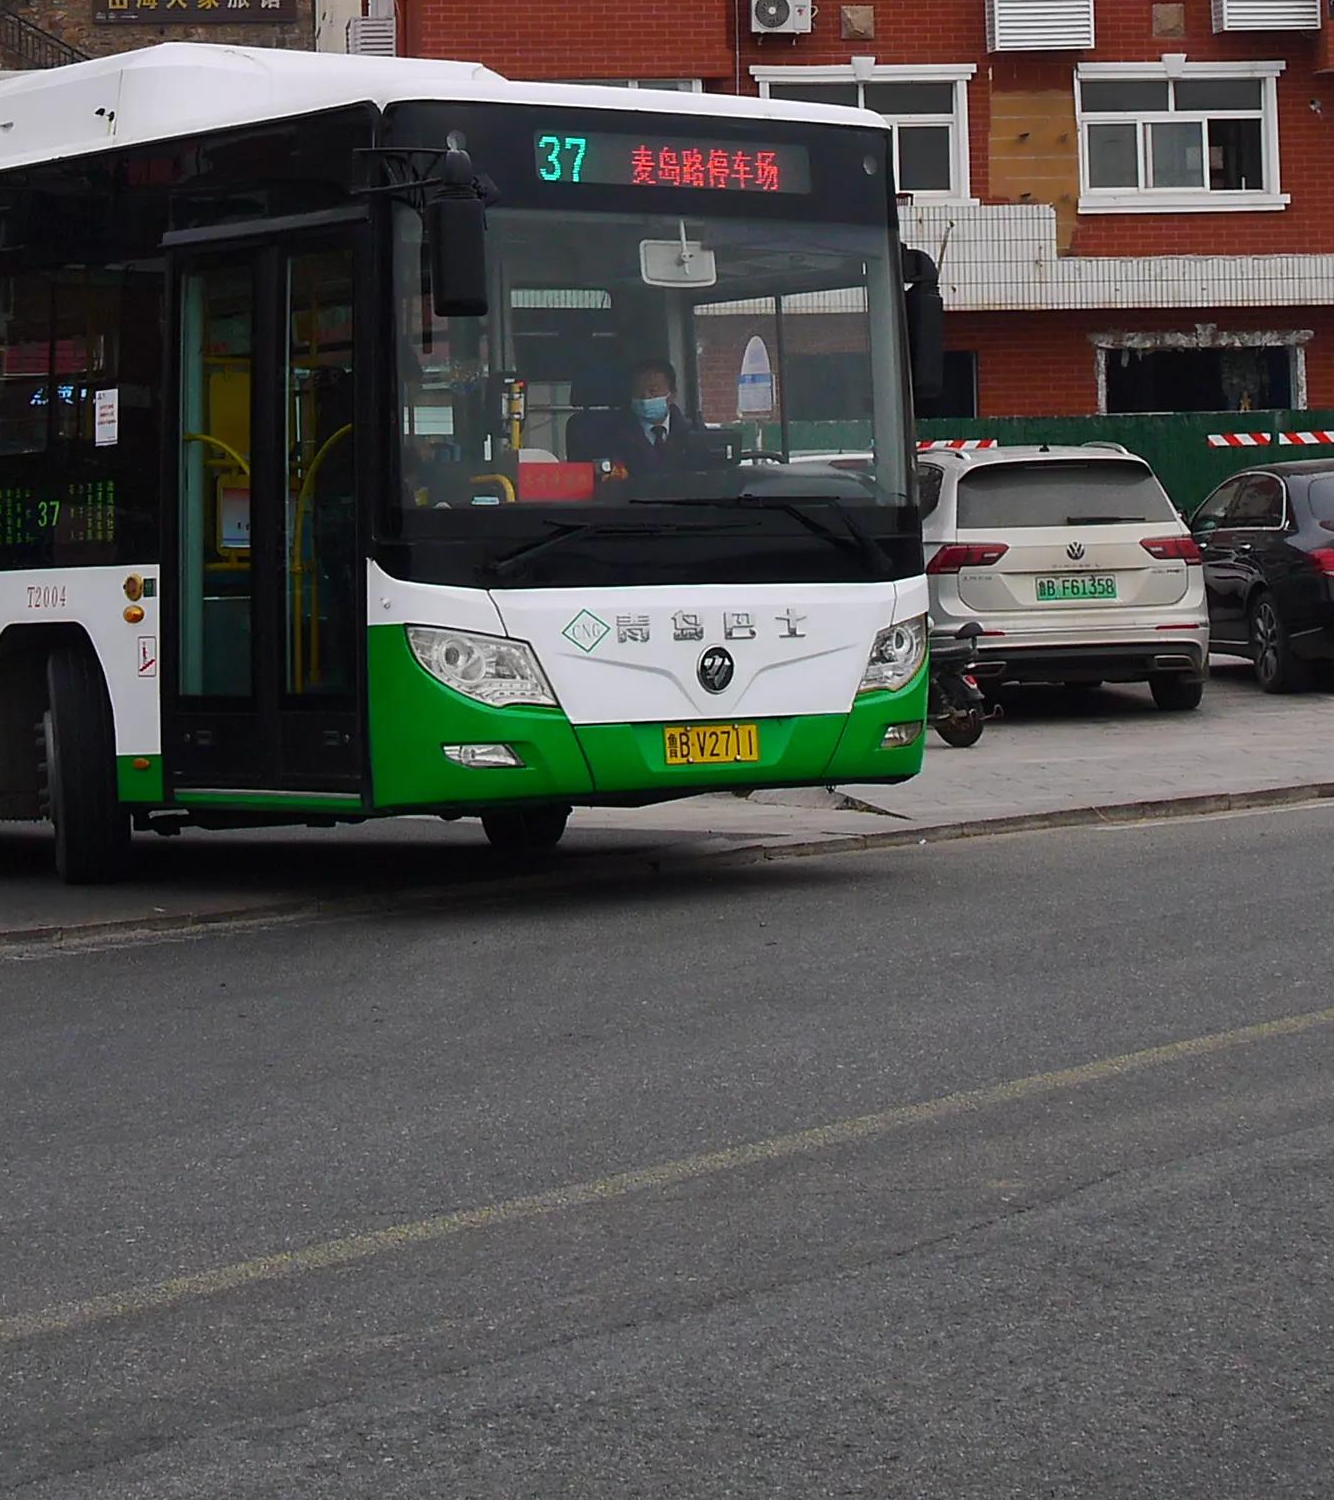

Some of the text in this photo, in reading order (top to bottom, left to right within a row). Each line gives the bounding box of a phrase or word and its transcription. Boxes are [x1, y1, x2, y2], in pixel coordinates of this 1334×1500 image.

[538, 136, 587, 182] 37
[631, 144, 779, 191] 麦岛路停车场
[37, 500, 61, 528] 37
[27, 585, 67, 609] T2004
[571, 623, 602, 639] CNG
[616, 608, 808, 644] 青岛巴士
